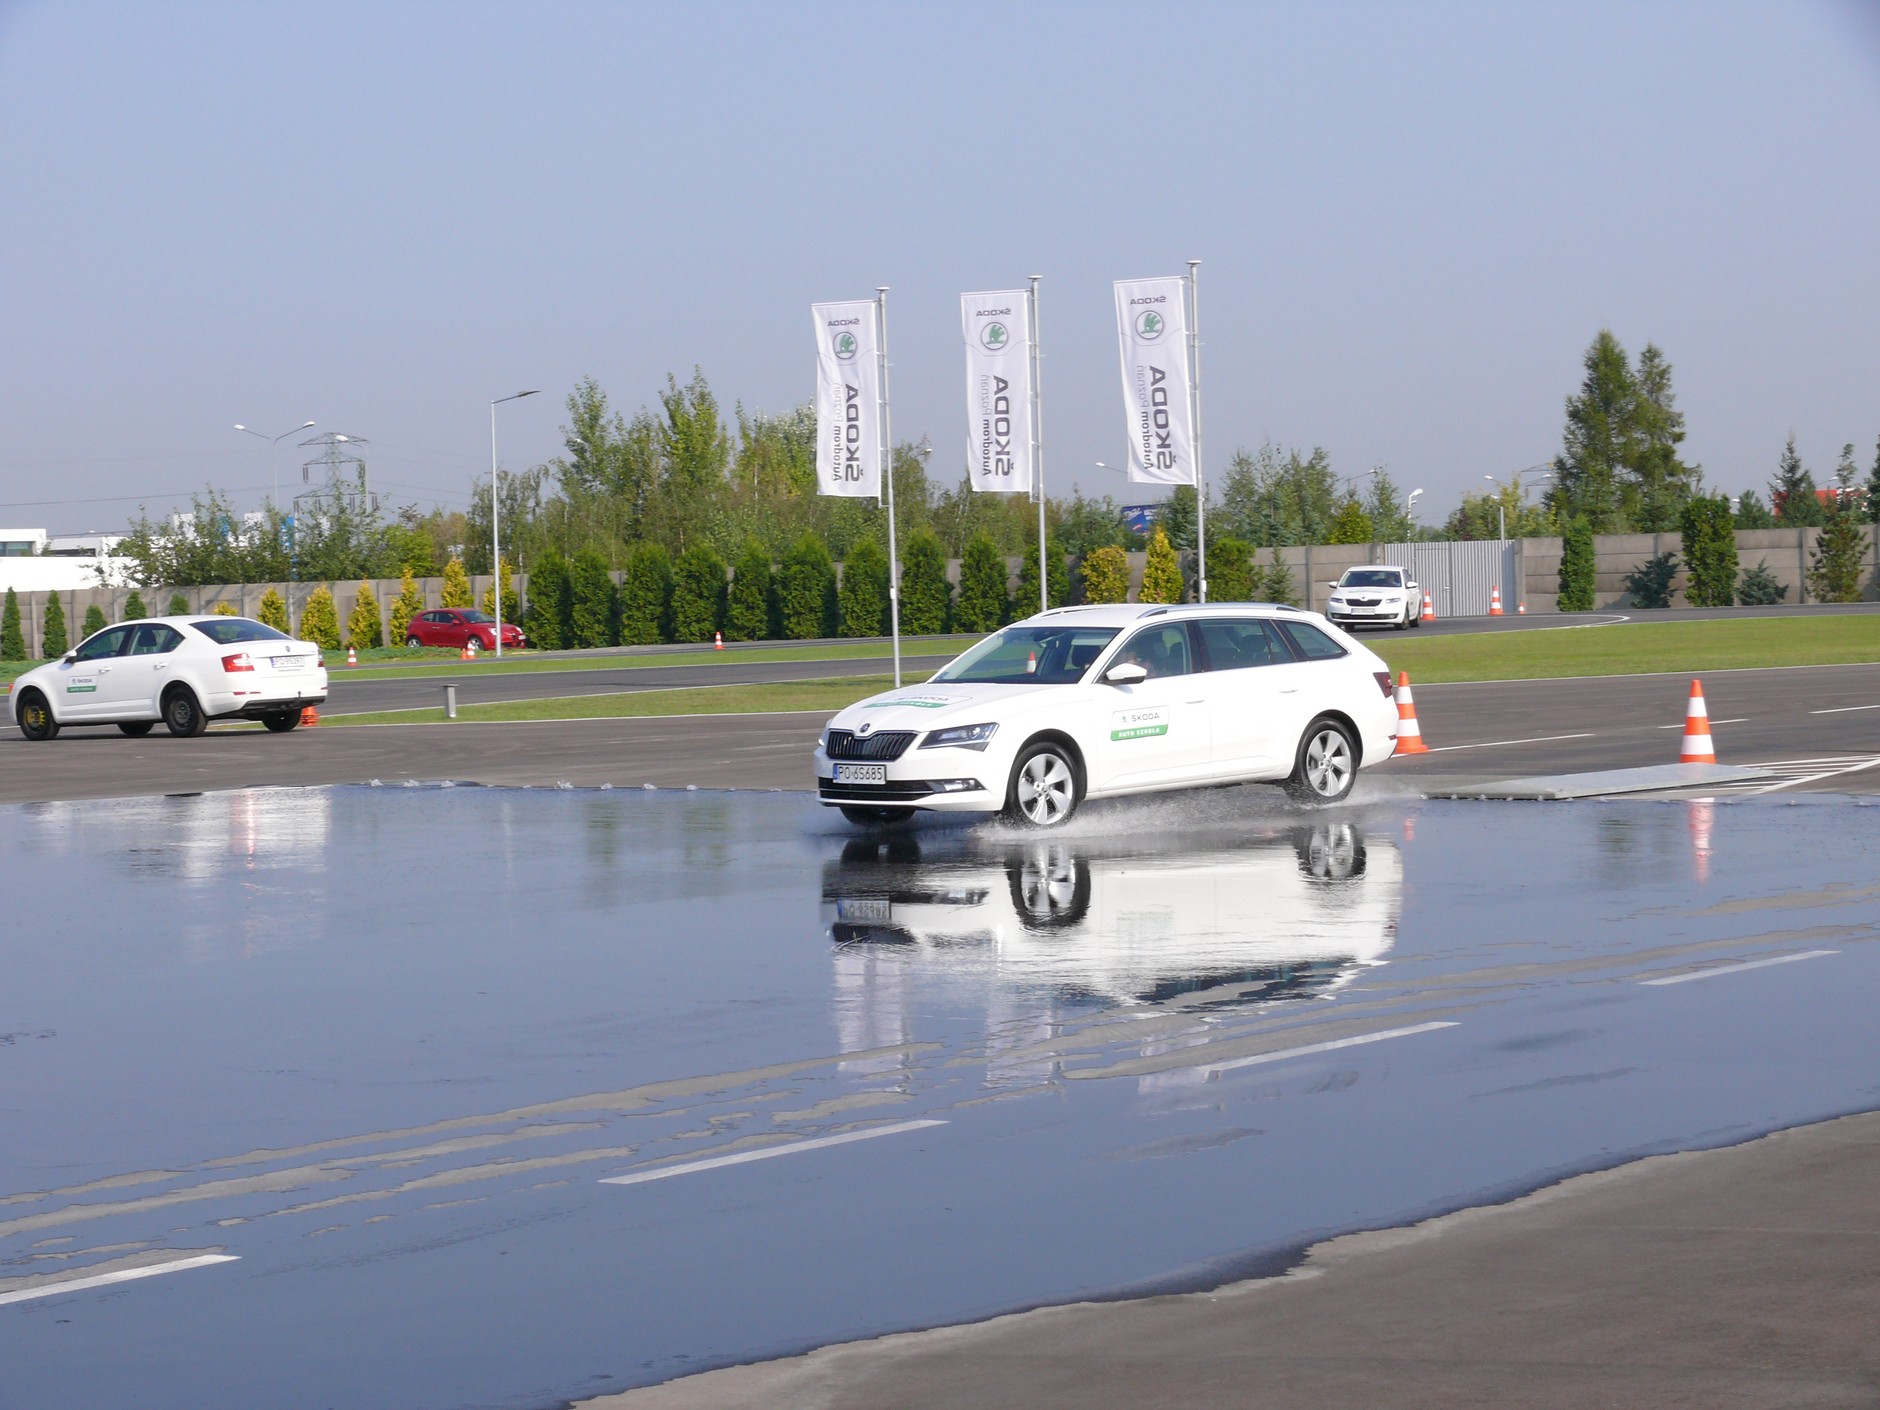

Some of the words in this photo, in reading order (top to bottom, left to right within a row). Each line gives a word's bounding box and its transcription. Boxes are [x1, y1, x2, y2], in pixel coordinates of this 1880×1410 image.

[1118, 730, 1135, 738] AUTO
[838, 766, 850, 779] PO
[854, 766, 882, 780] 6S685
